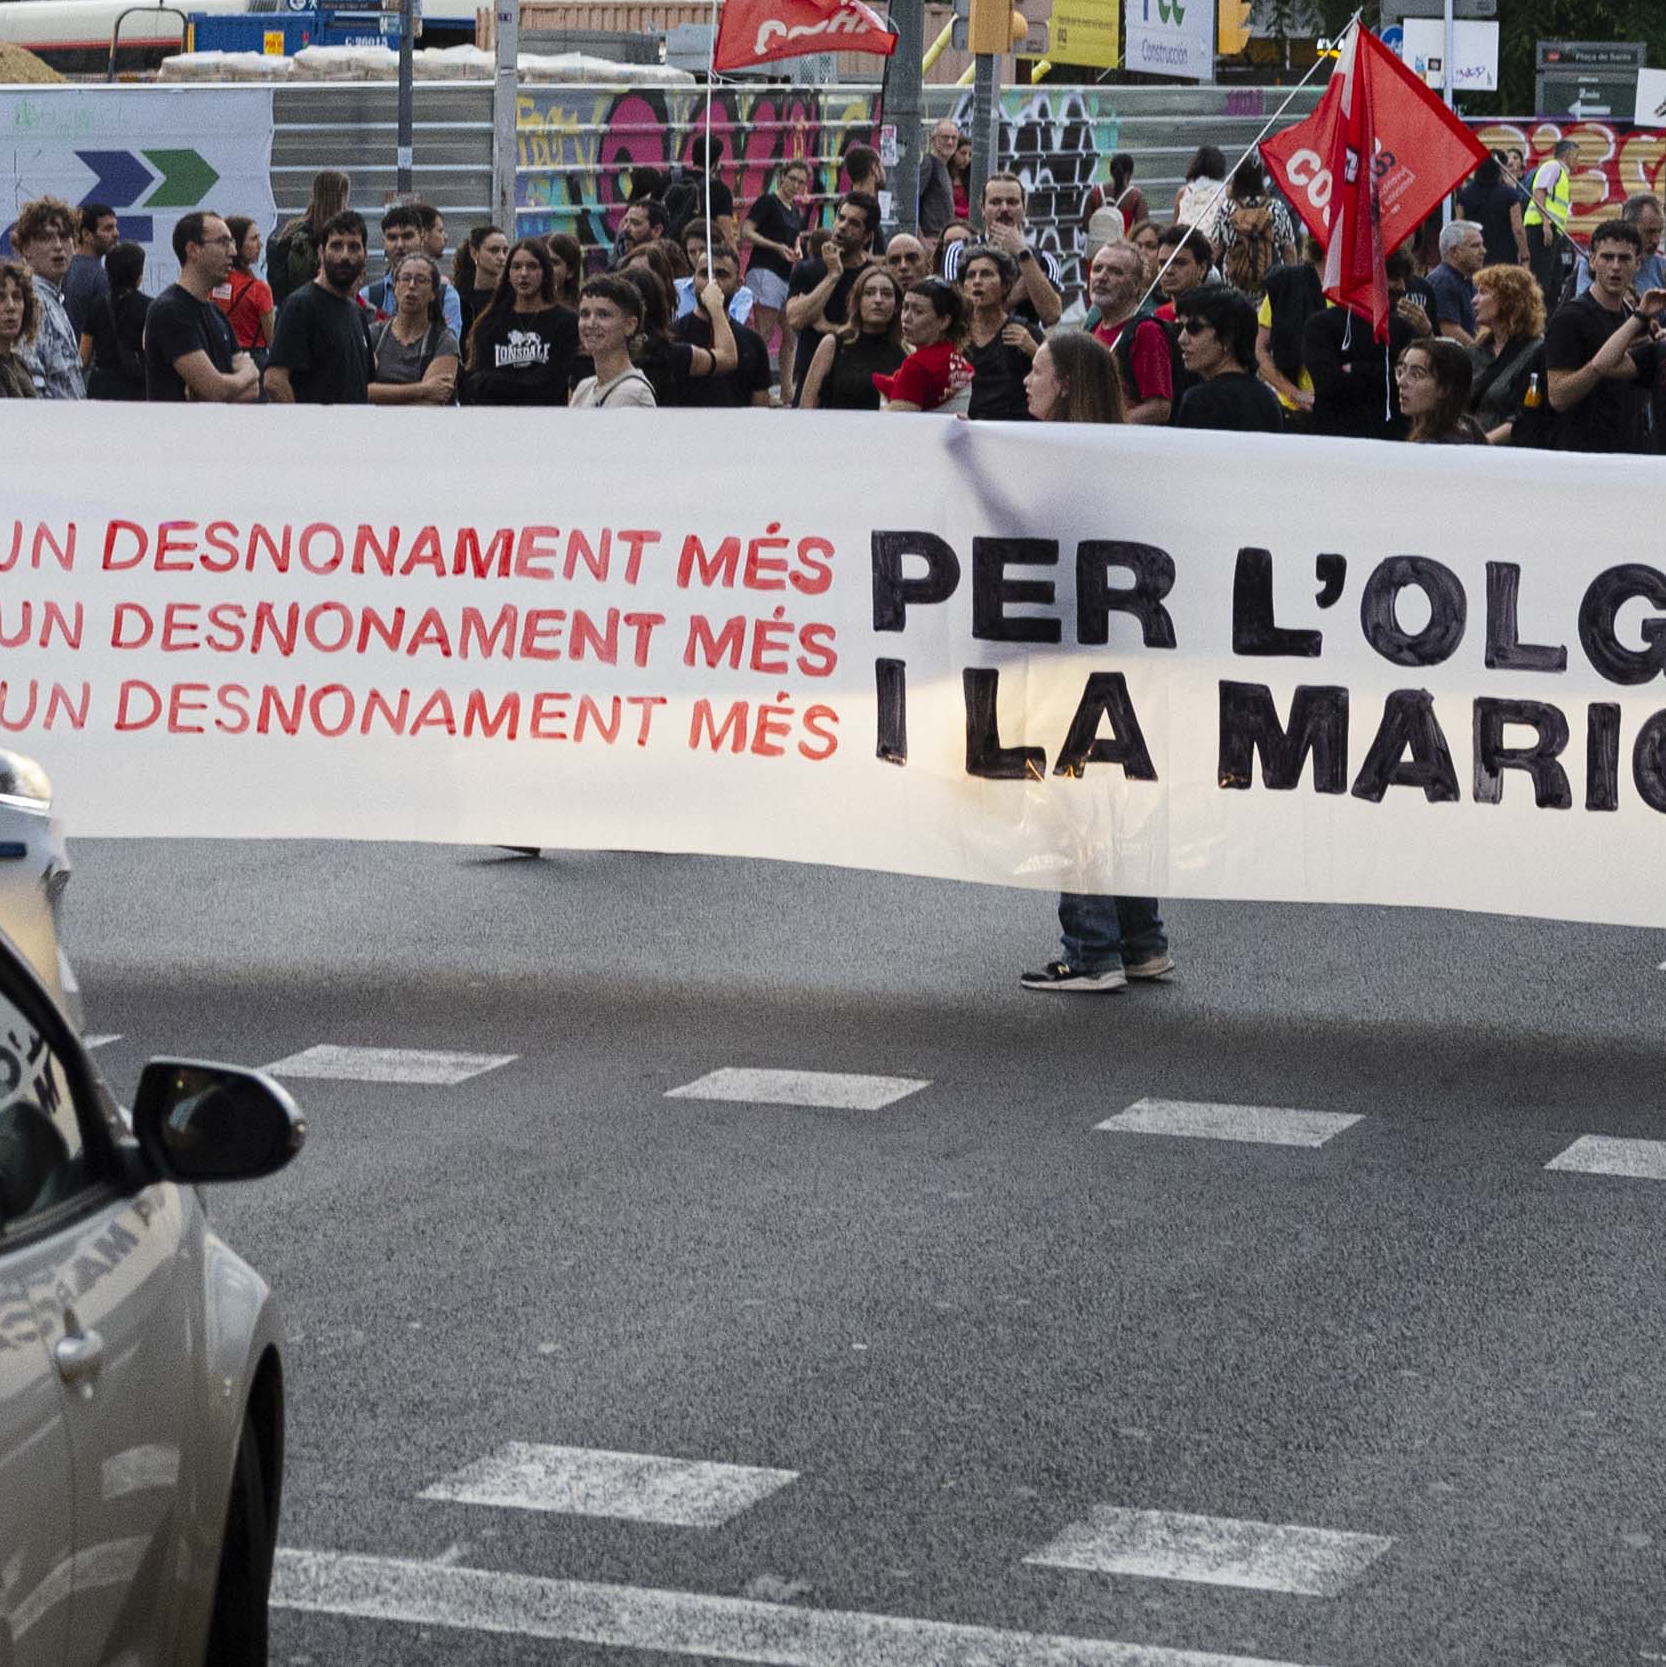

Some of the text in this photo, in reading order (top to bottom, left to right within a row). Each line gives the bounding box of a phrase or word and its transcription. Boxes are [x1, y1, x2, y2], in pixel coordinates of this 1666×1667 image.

[1141, 37, 1189, 66] Construcción
[494, 342, 552, 368] LONSDALE
[102, 519, 662, 585] DESNONAMENT
[677, 521, 836, 596] MÉS
[871, 529, 1178, 649] PER
[111, 600, 666, 668] DESNONAMENT
[683, 605, 839, 678] MÉS
[115, 679, 667, 746] DESNONAMENT
[688, 692, 840, 762] MÉS
[875, 657, 908, 767] I
[962, 666, 1159, 782] LA
